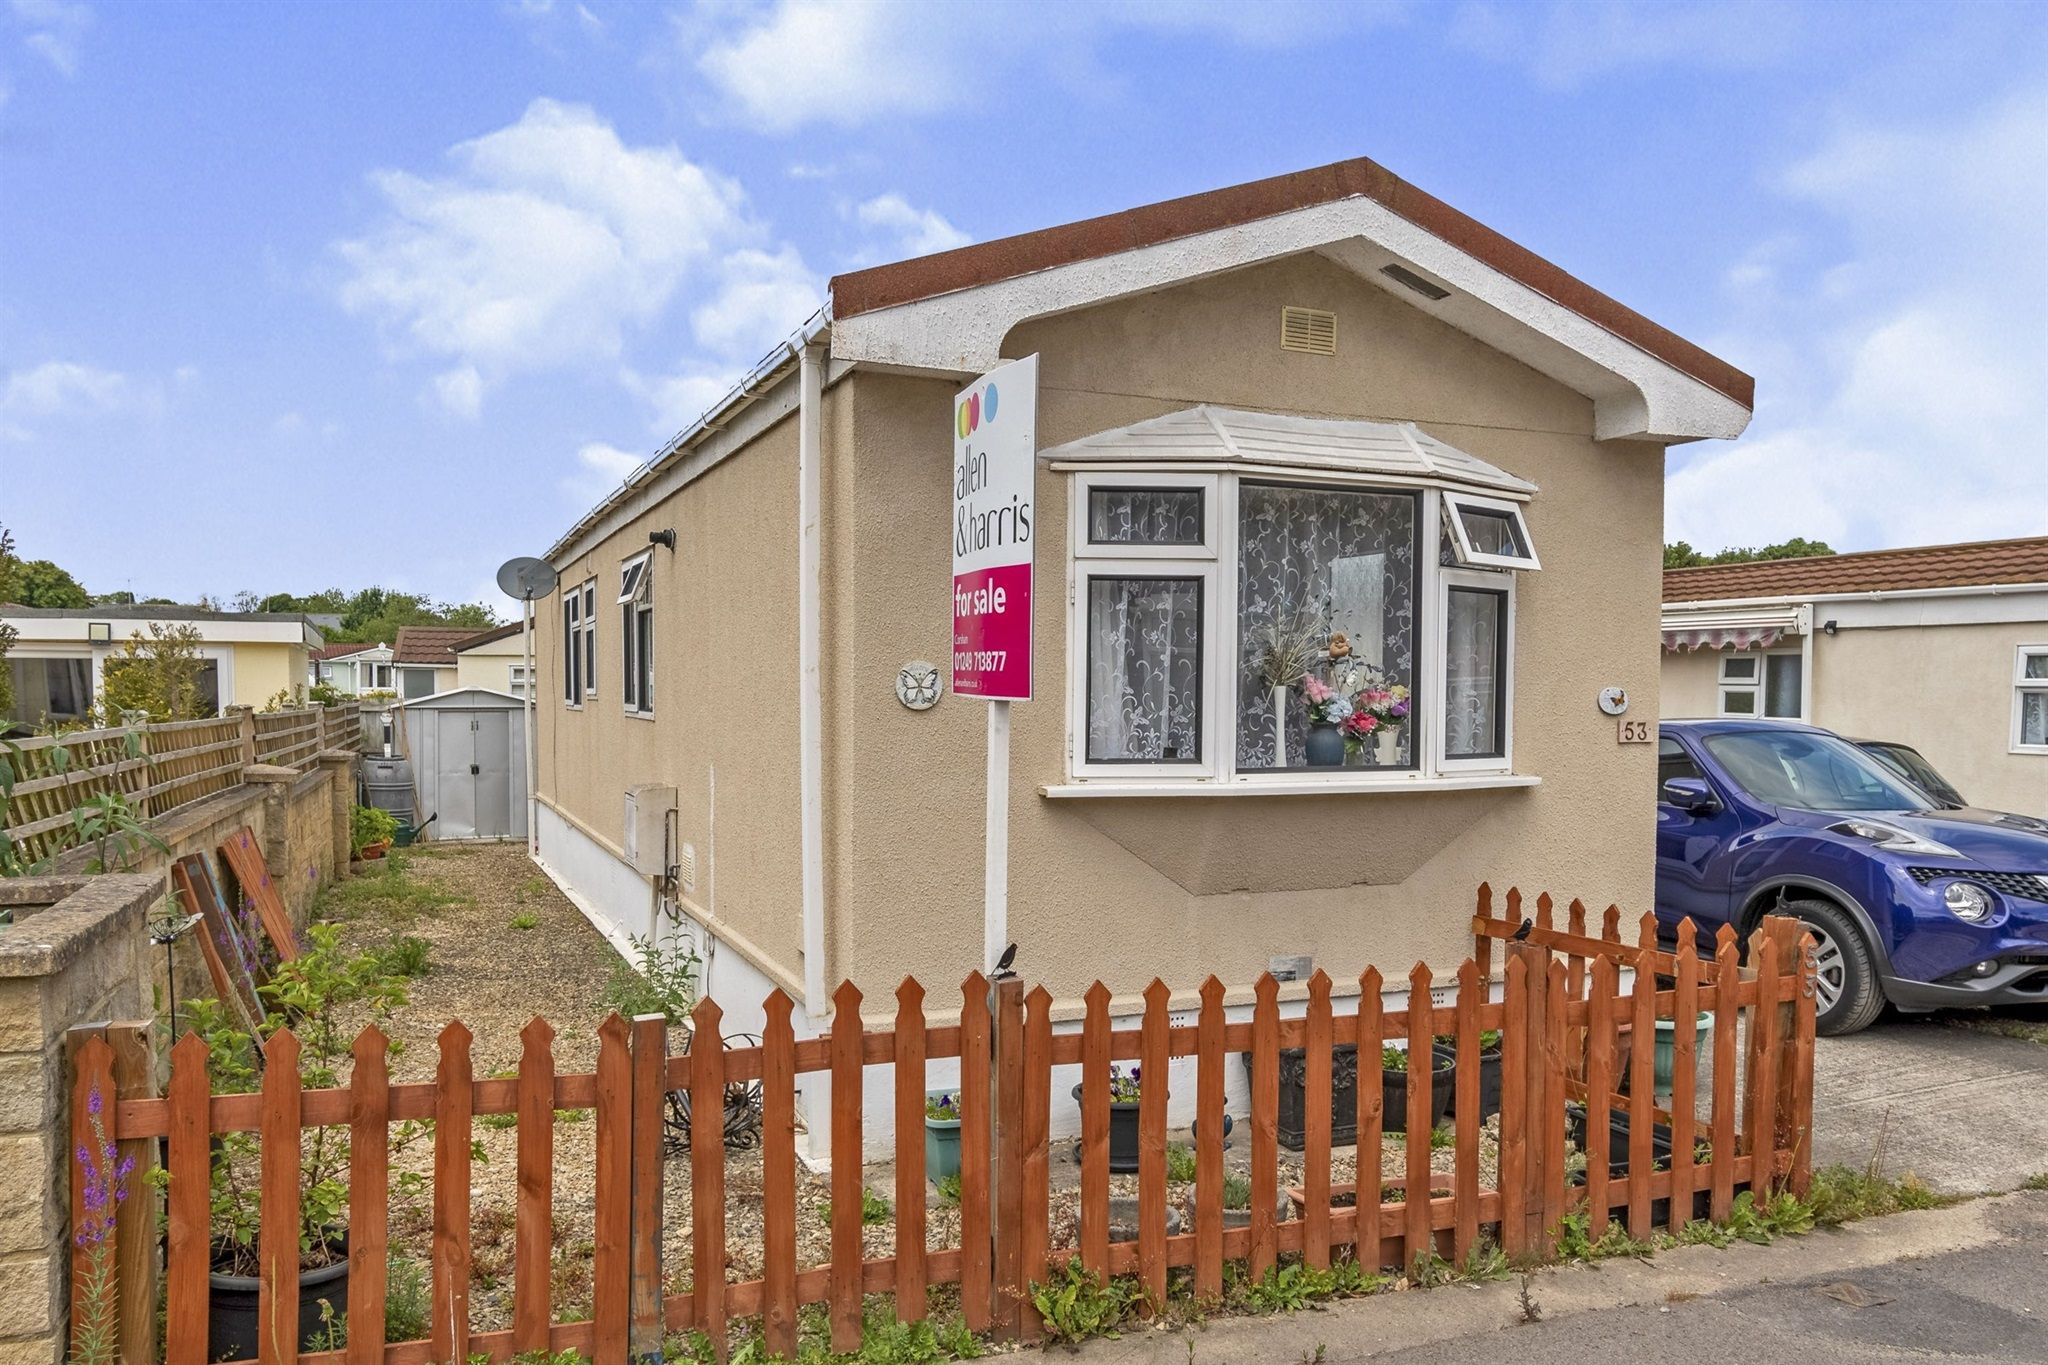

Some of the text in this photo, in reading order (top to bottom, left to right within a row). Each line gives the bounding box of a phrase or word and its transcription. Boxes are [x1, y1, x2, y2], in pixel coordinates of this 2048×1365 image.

[956, 444, 987, 500] allen
[955, 578, 1006, 617] for sale
[974, 651, 1007, 672] 713877
[1625, 721, 1647, 740] 53
